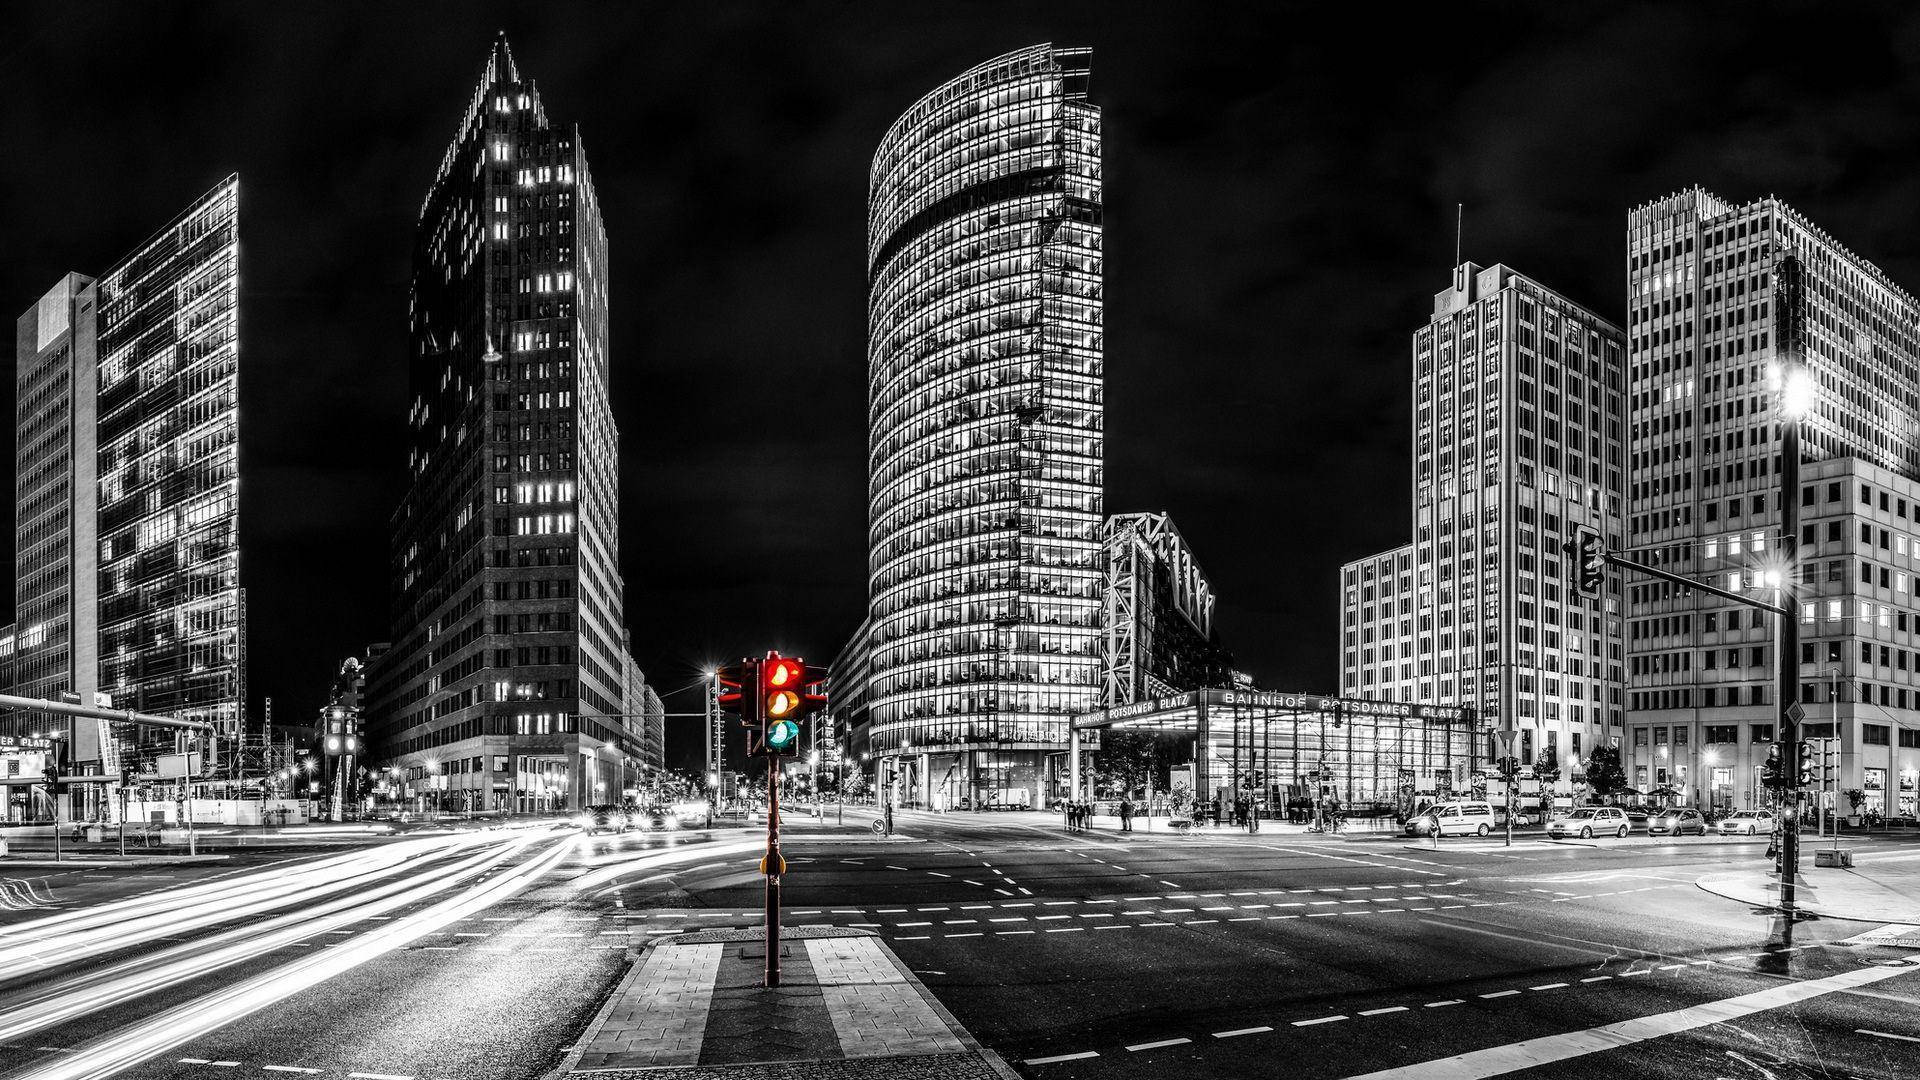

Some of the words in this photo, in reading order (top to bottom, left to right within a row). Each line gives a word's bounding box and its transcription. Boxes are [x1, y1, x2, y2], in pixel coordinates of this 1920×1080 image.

[1075, 712, 1105, 725] BAHNHOF
[1109, 702, 1154, 719] POTSDAMER
[1160, 694, 1189, 709] PLATZ
[1225, 693, 1306, 707] BAHNHOF
[1422, 708, 1462, 719] PLATZ
[22, 738, 51, 748] PLATZ
